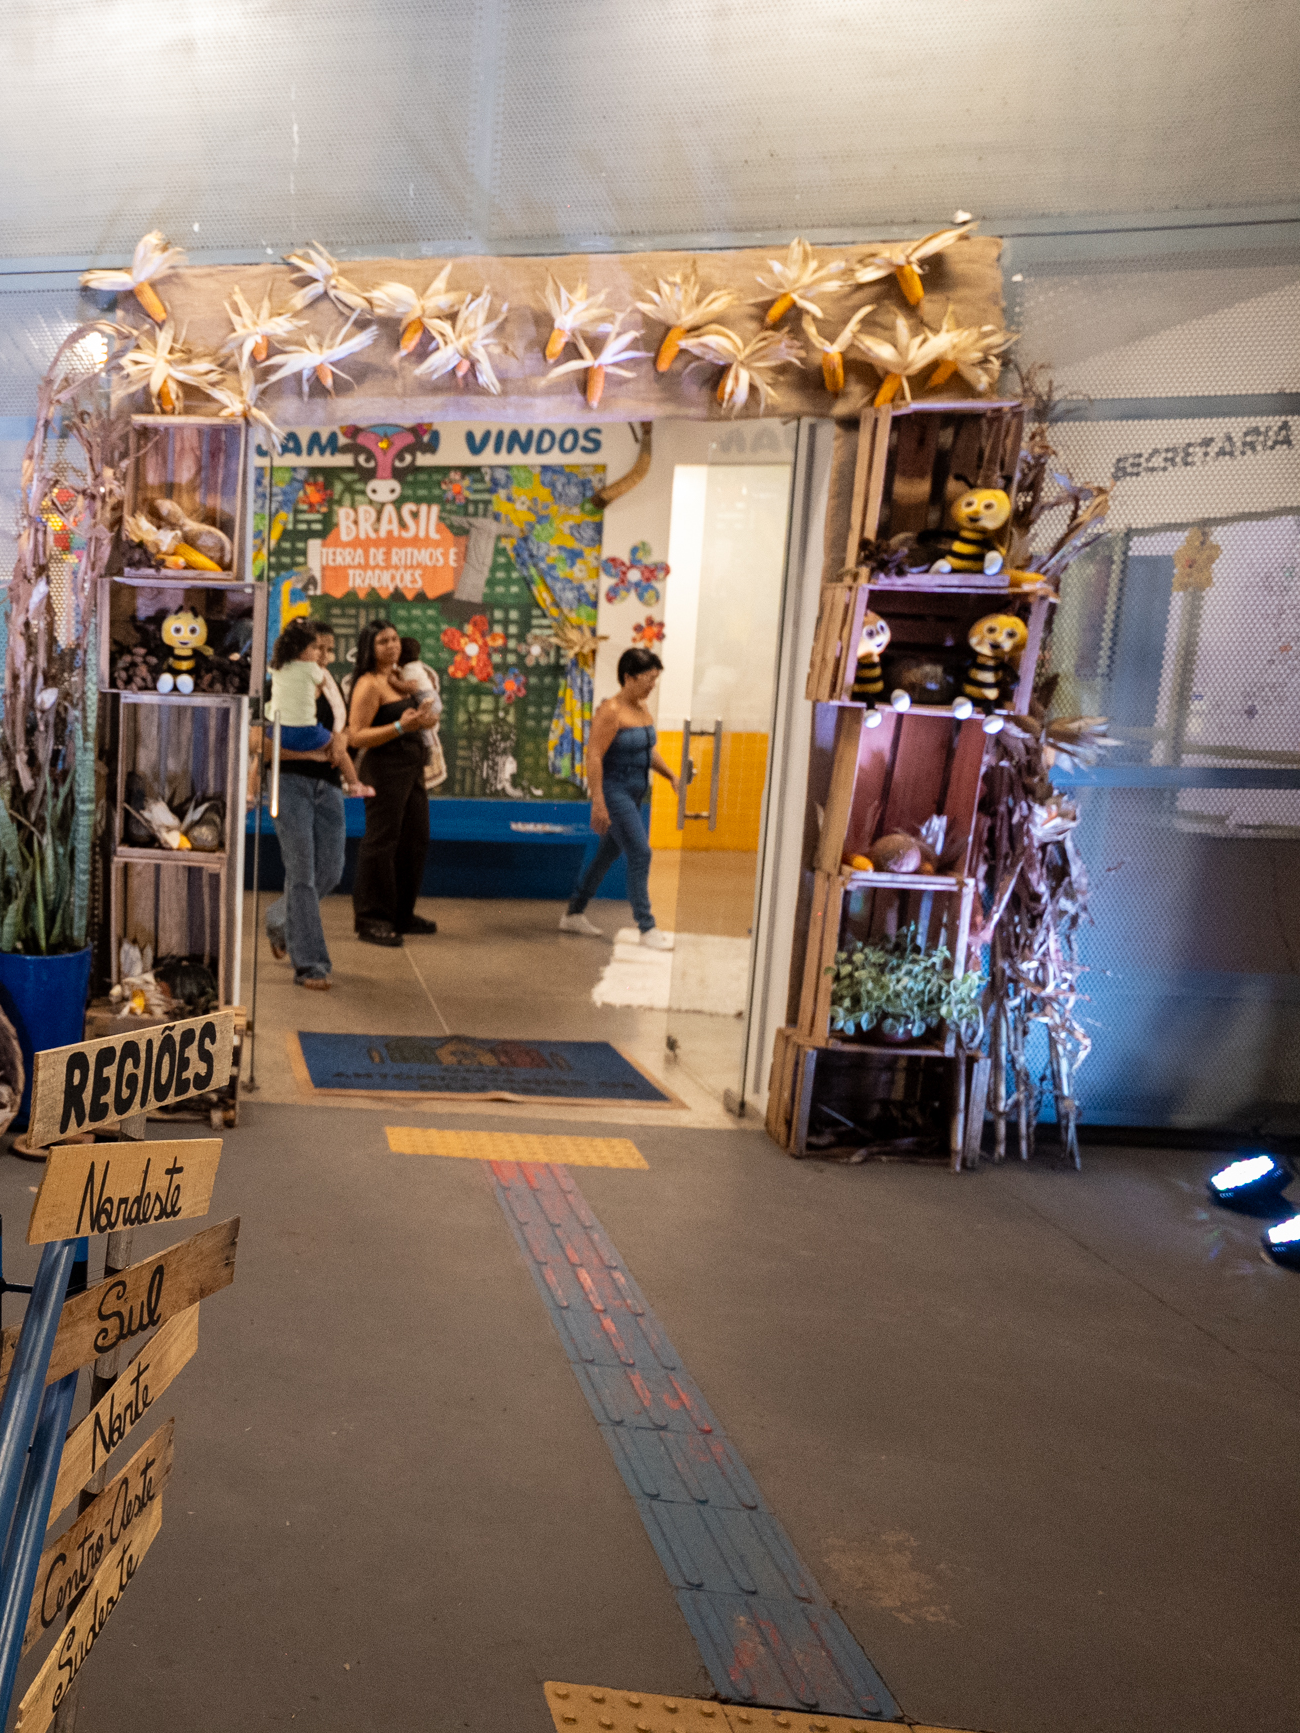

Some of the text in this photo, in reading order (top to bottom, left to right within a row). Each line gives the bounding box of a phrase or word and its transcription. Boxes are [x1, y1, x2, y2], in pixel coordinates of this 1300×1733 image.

[465, 427, 602, 456] VINDOS
[321, 547, 458, 567] TERRA DE RITMOS E
[338, 502, 441, 541] BRASIL
[348, 565, 423, 592] TRADIÇÕES
[59, 1021, 217, 1135] REGIÕES
[76, 1156, 184, 1235] Nordeste
[93, 1264, 165, 1354] Sul
[91, 1361, 155, 1474] Norte
[52, 1540, 140, 1713] Sudeste
